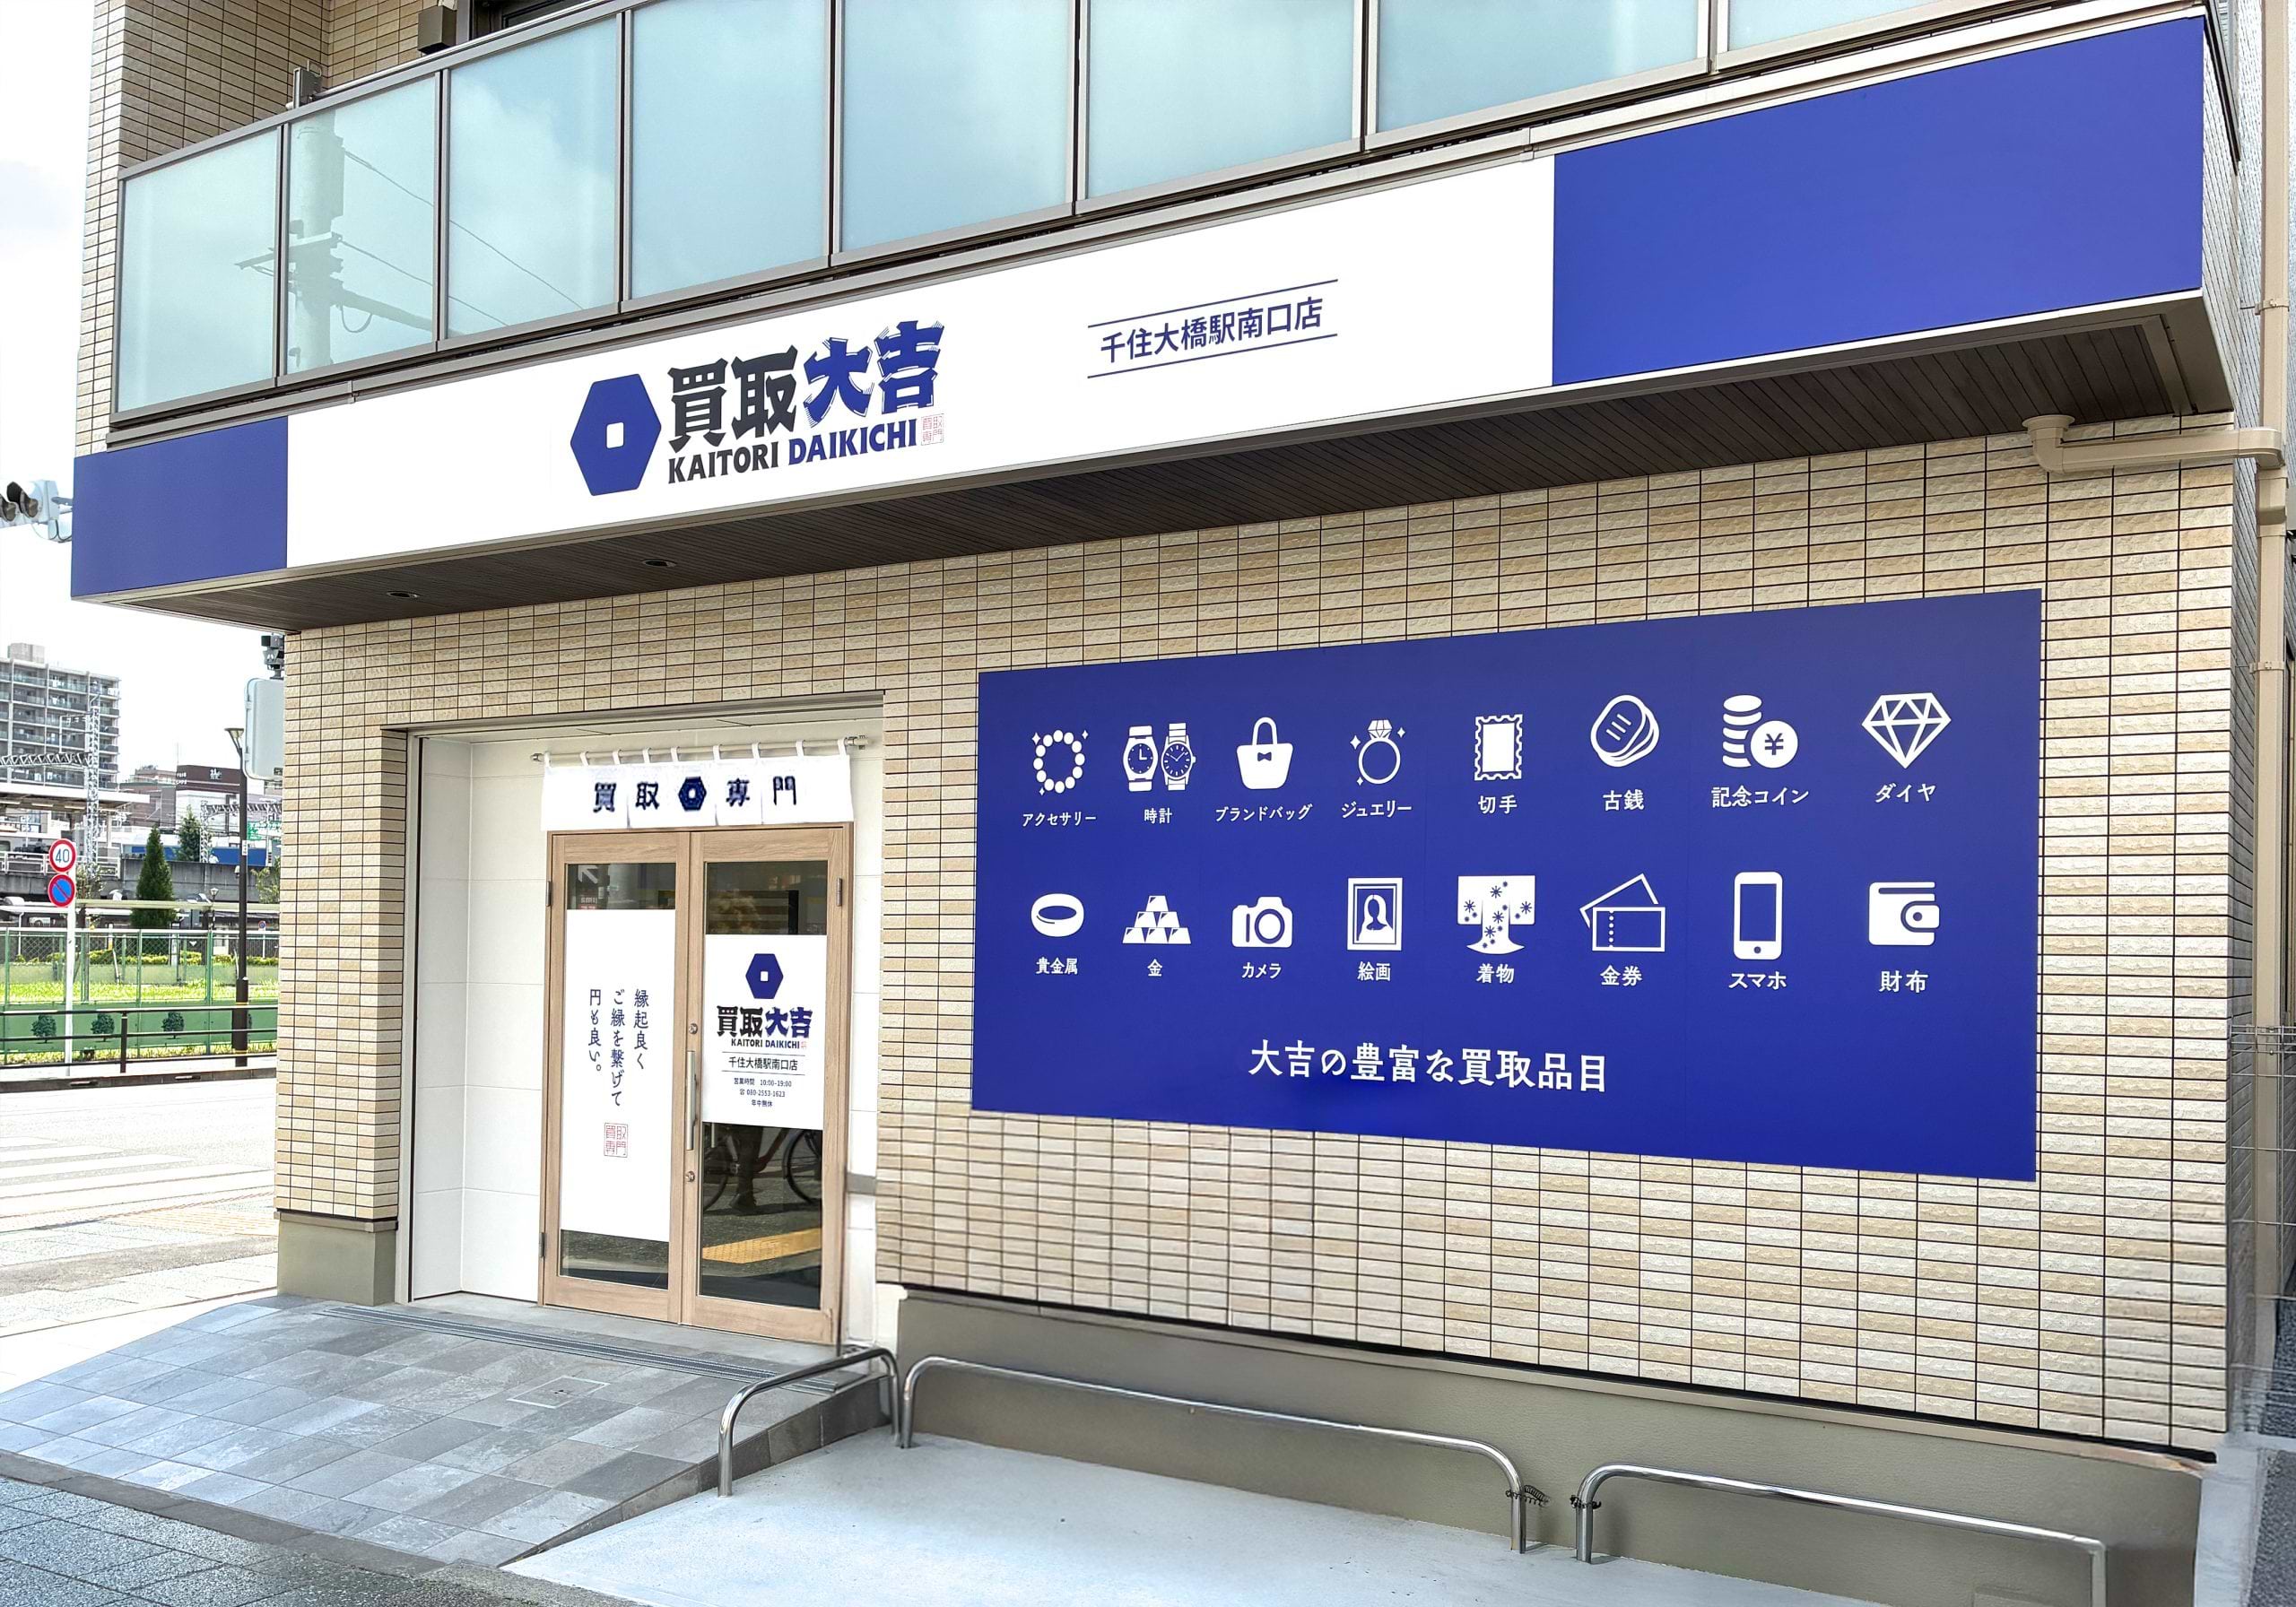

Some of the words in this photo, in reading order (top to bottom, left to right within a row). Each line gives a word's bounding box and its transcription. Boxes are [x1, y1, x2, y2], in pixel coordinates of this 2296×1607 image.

[1100, 296, 1323, 363] 千住大橋駅南口店
[666, 318, 946, 454] 買取大吉
[667, 440, 779, 484] KAITORI
[787, 418, 918, 465] DAIKICHI
[592, 781, 660, 813] 買取
[1477, 794, 1518, 814] 切手
[1602, 788, 1645, 812] 古銭
[1710, 785, 1809, 809] 記念コイン
[1875, 782, 1936, 804] ダイヤ
[1022, 811, 1097, 827] アクセサリー
[1144, 807, 1173, 824] 時計
[1215, 803, 1313, 822] ブランドバッグ
[1341, 800, 1413, 819] ジュエリー
[54, 847, 71, 864] 40
[1035, 956, 1078, 975] 貴金属
[1147, 958, 1163, 977] 金
[1241, 961, 1282, 979] カメラ
[1357, 960, 1391, 982] 絵画
[1475, 962, 1515, 984] 着物
[1599, 964, 1643, 986] 金券
[1728, 970, 1787, 990] スマホ
[1878, 969, 1929, 994] 財布
[587, 988, 602, 1072] 円も良い。
[633, 988, 649, 1070] 縁起良く
[716, 1004, 813, 1038] 買取大吉
[610, 988, 626, 1107] ご縁を繋げて
[731, 1038, 763, 1047] KAITORI
[765, 1039, 800, 1049] DAIKICHI
[728, 1055, 798, 1071] 千住大橋駅南口店
[1248, 1038, 1605, 1092] 大吉の豊富な買取品目
